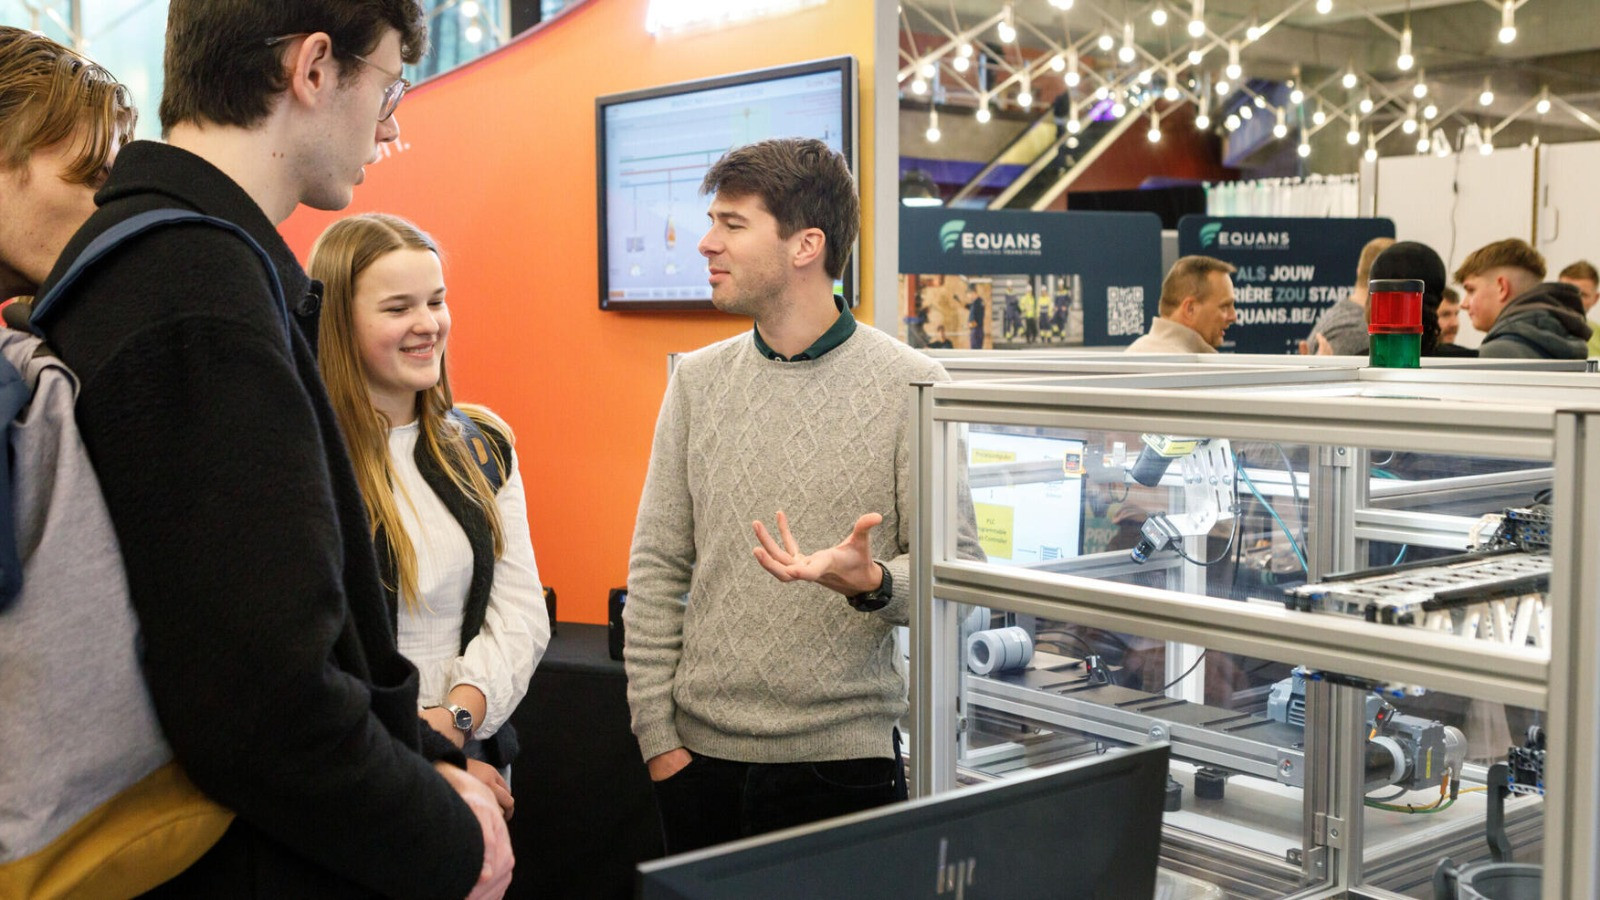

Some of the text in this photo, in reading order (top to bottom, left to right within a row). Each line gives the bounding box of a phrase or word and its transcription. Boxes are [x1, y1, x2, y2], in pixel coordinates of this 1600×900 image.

[961, 232, 1042, 249] EQUANS
[1218, 231, 1290, 246] EQUANS
[1236, 266, 1315, 281] ALS JOUW
[1275, 287, 1306, 302] ZOU
